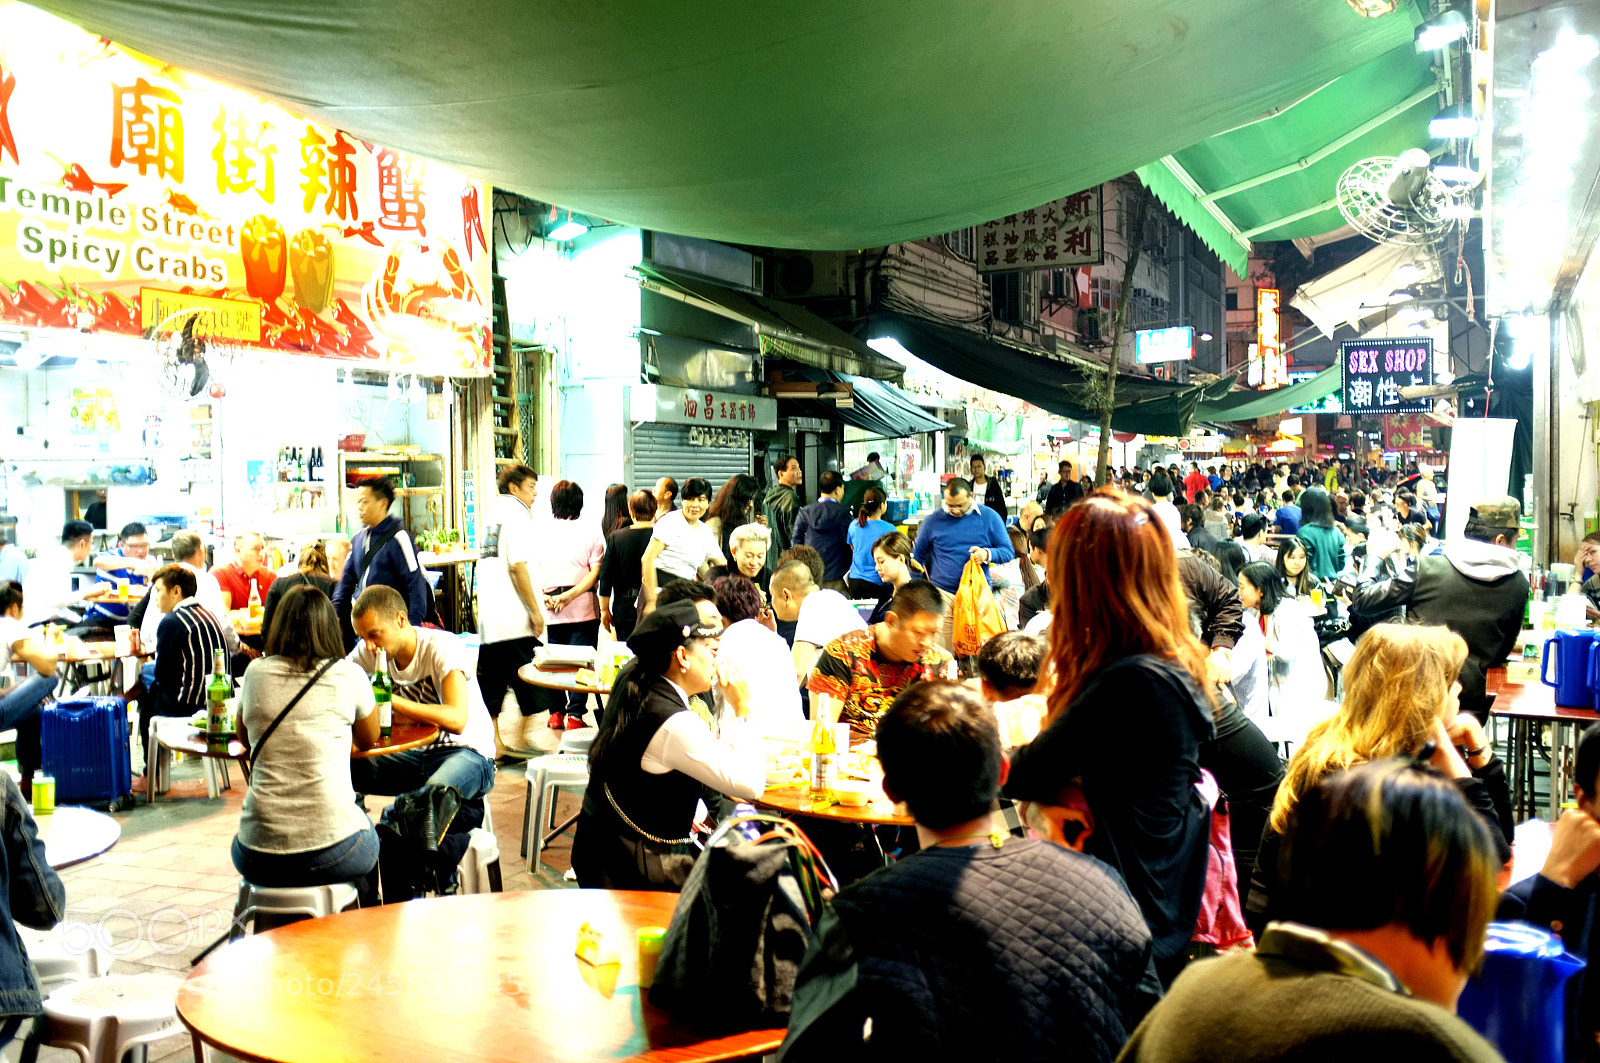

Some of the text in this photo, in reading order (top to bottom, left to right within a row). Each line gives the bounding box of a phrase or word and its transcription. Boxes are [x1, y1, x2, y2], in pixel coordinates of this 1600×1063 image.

[109, 77, 427, 237] 廟街辣蟹
[0, 176, 236, 247] Temple Street
[23, 226, 225, 284] Spicy Crabs
[1348, 348, 1427, 374] SEX SHOP
